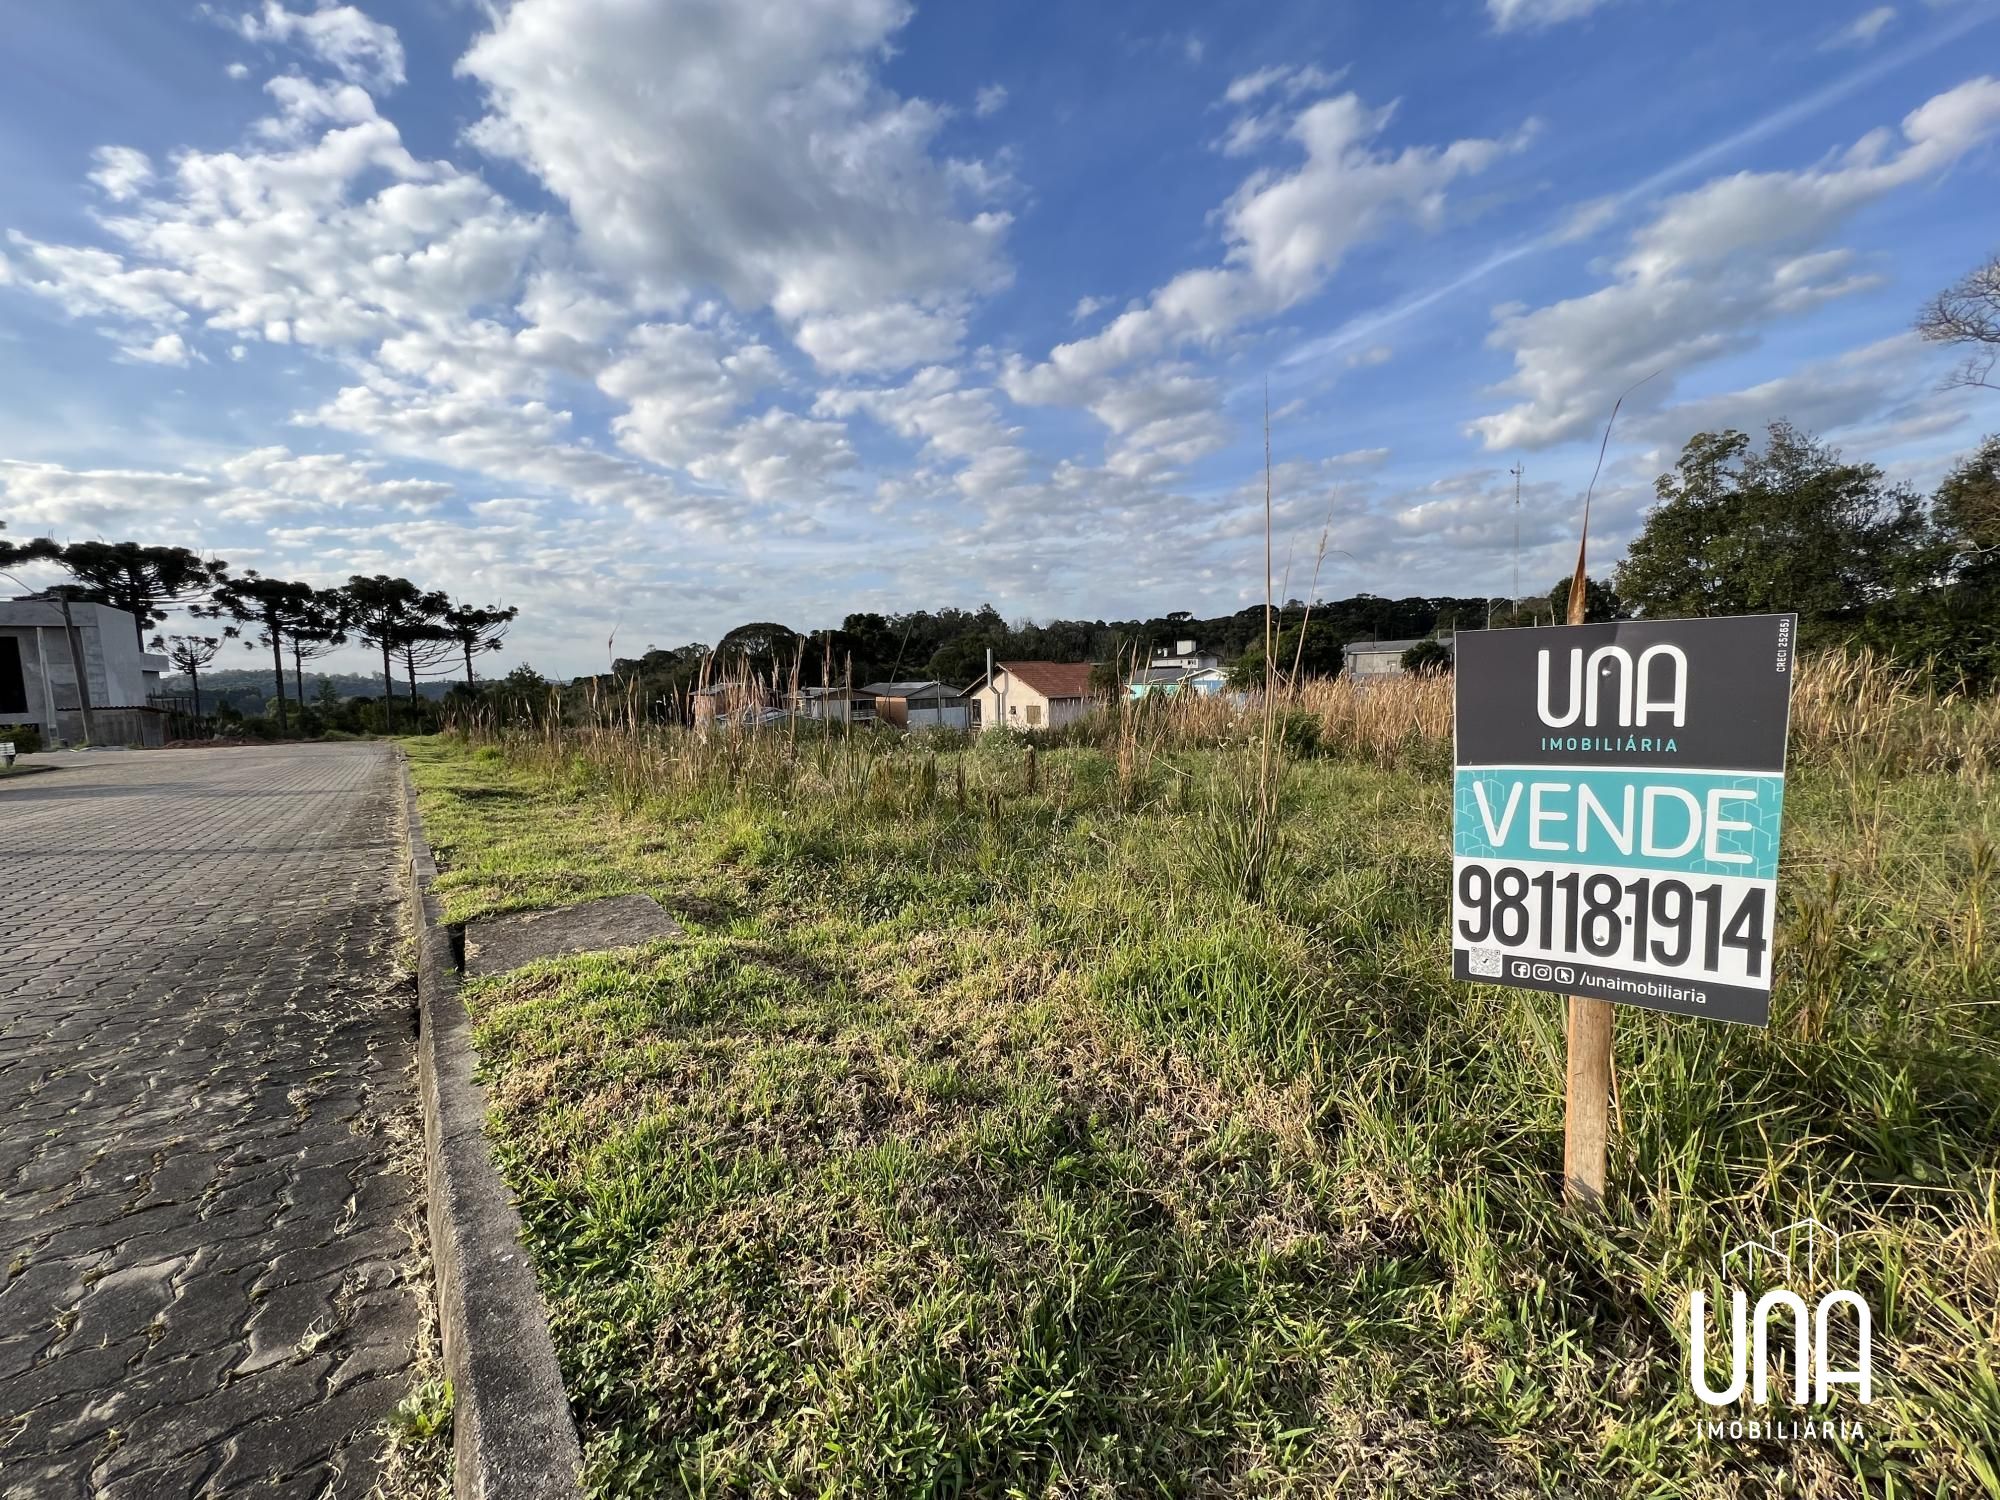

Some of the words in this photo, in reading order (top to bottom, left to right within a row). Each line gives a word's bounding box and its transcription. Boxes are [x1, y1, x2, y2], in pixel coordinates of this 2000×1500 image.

[1776, 650, 1787, 672] CRECI
[1537, 645, 1688, 728] UNA
[1541, 733, 1678, 753] IMOBILIÁRIA
[1472, 781, 1757, 864] VENDE
[1579, 971, 1706, 1005] /unaimobiliaria
